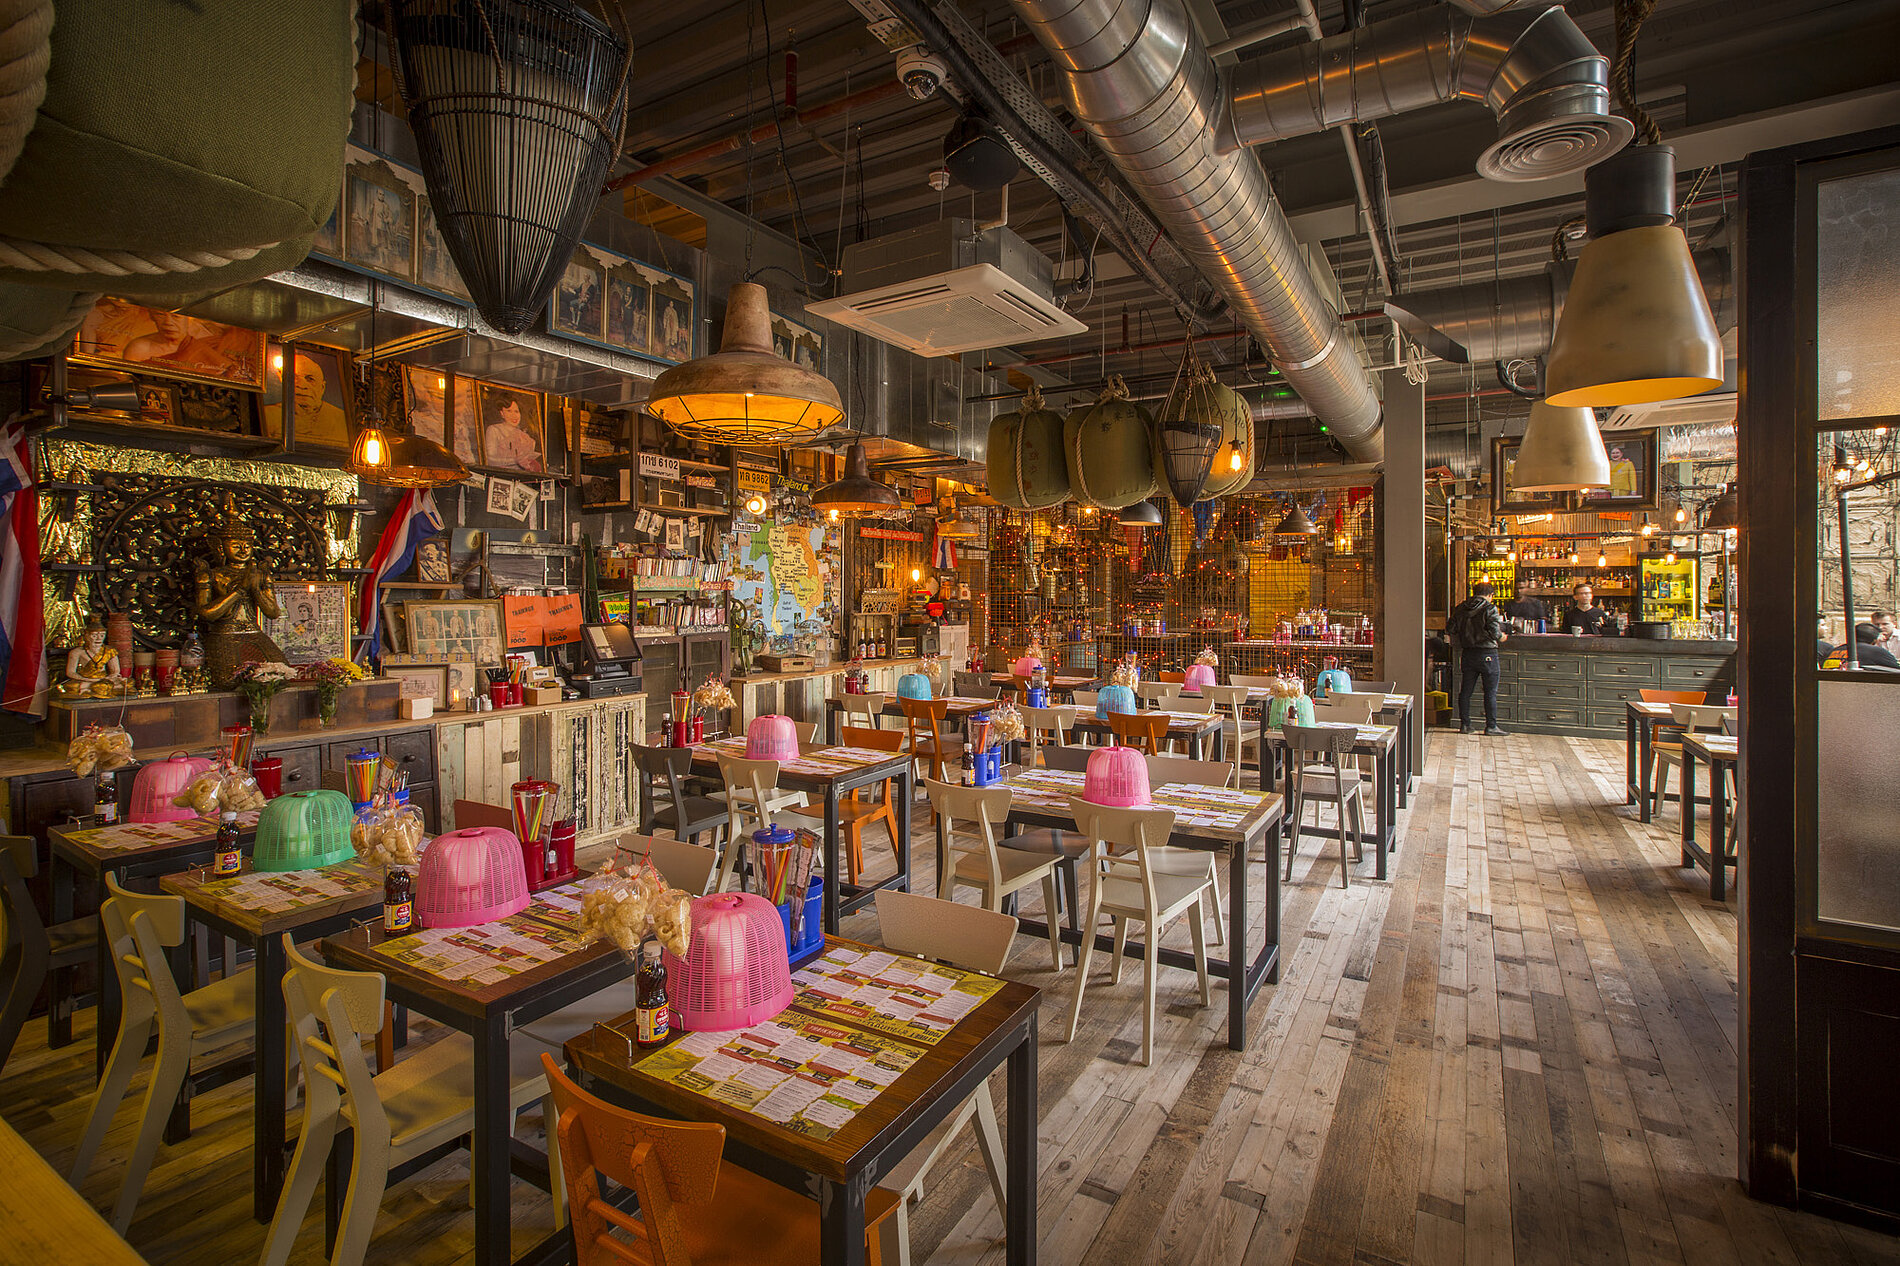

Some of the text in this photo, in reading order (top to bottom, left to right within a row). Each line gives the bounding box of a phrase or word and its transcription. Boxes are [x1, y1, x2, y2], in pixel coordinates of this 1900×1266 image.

[658, 457, 678, 470] 6102
[751, 472, 769, 485] 9862
[776, 474, 802, 491] Thailand
[734, 522, 758, 531] Thailand
